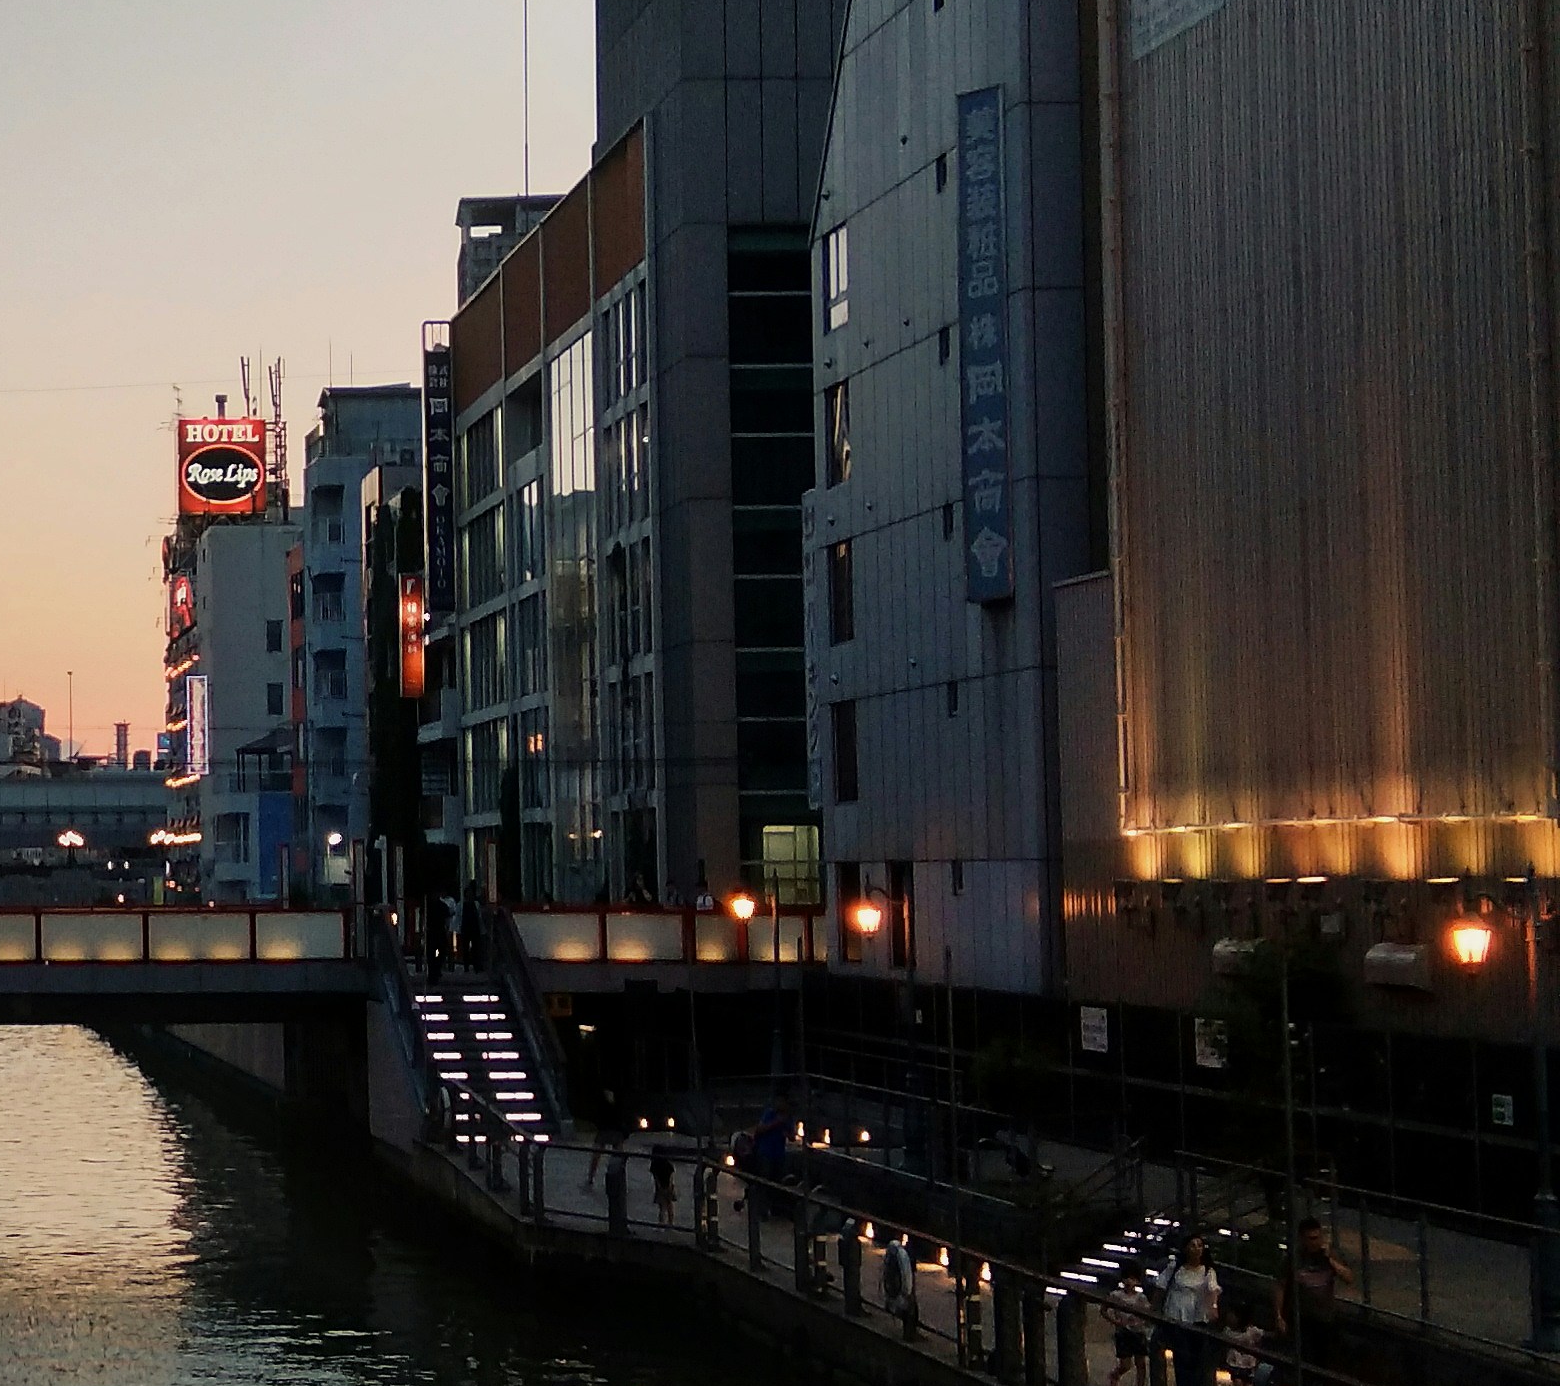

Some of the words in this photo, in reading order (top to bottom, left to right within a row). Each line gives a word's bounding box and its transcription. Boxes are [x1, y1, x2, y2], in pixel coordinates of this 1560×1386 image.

[186, 424, 260, 442] HOTEL
[187, 463, 223, 485] Rose
[224, 463, 259, 488] Lips
